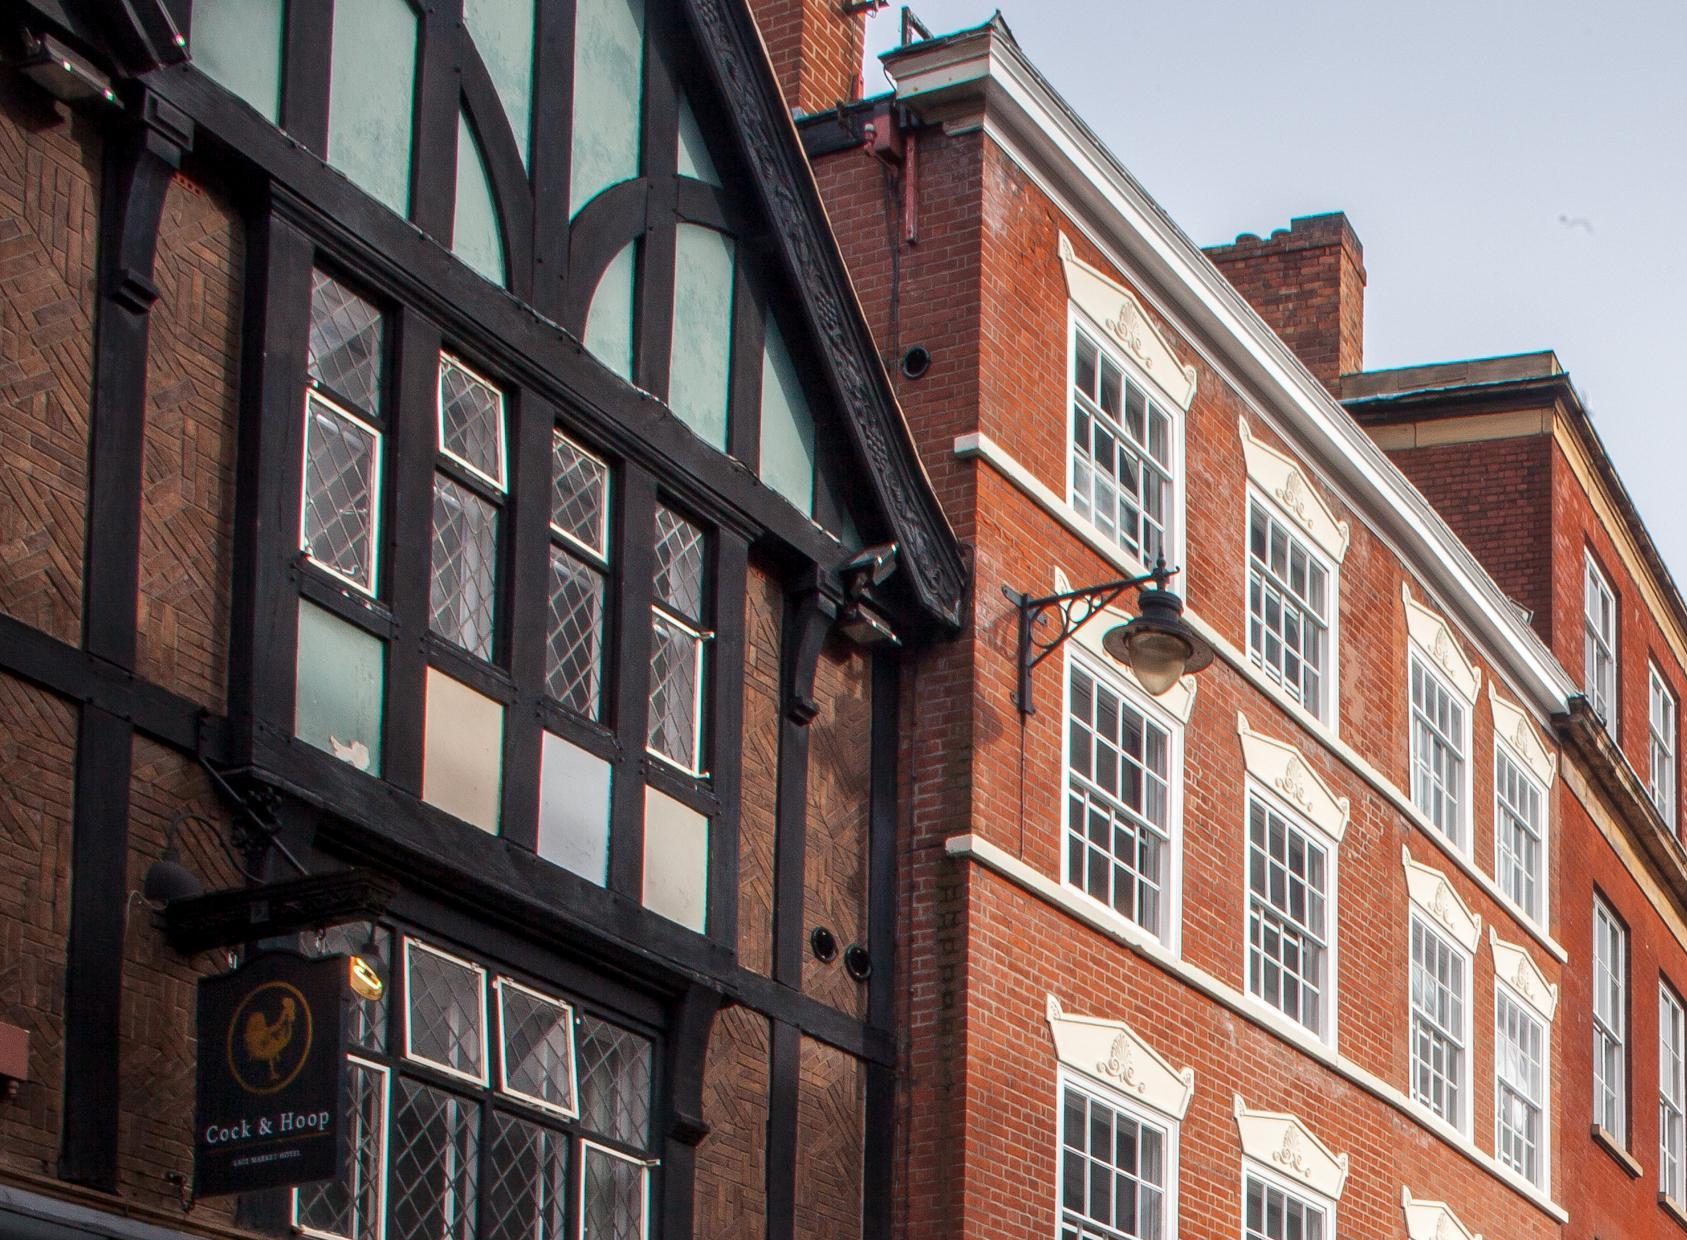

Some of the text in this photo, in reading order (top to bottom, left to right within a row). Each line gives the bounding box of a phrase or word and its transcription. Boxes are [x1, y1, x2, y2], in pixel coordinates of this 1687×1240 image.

[206, 1112, 329, 1143] Cock & Hoop
